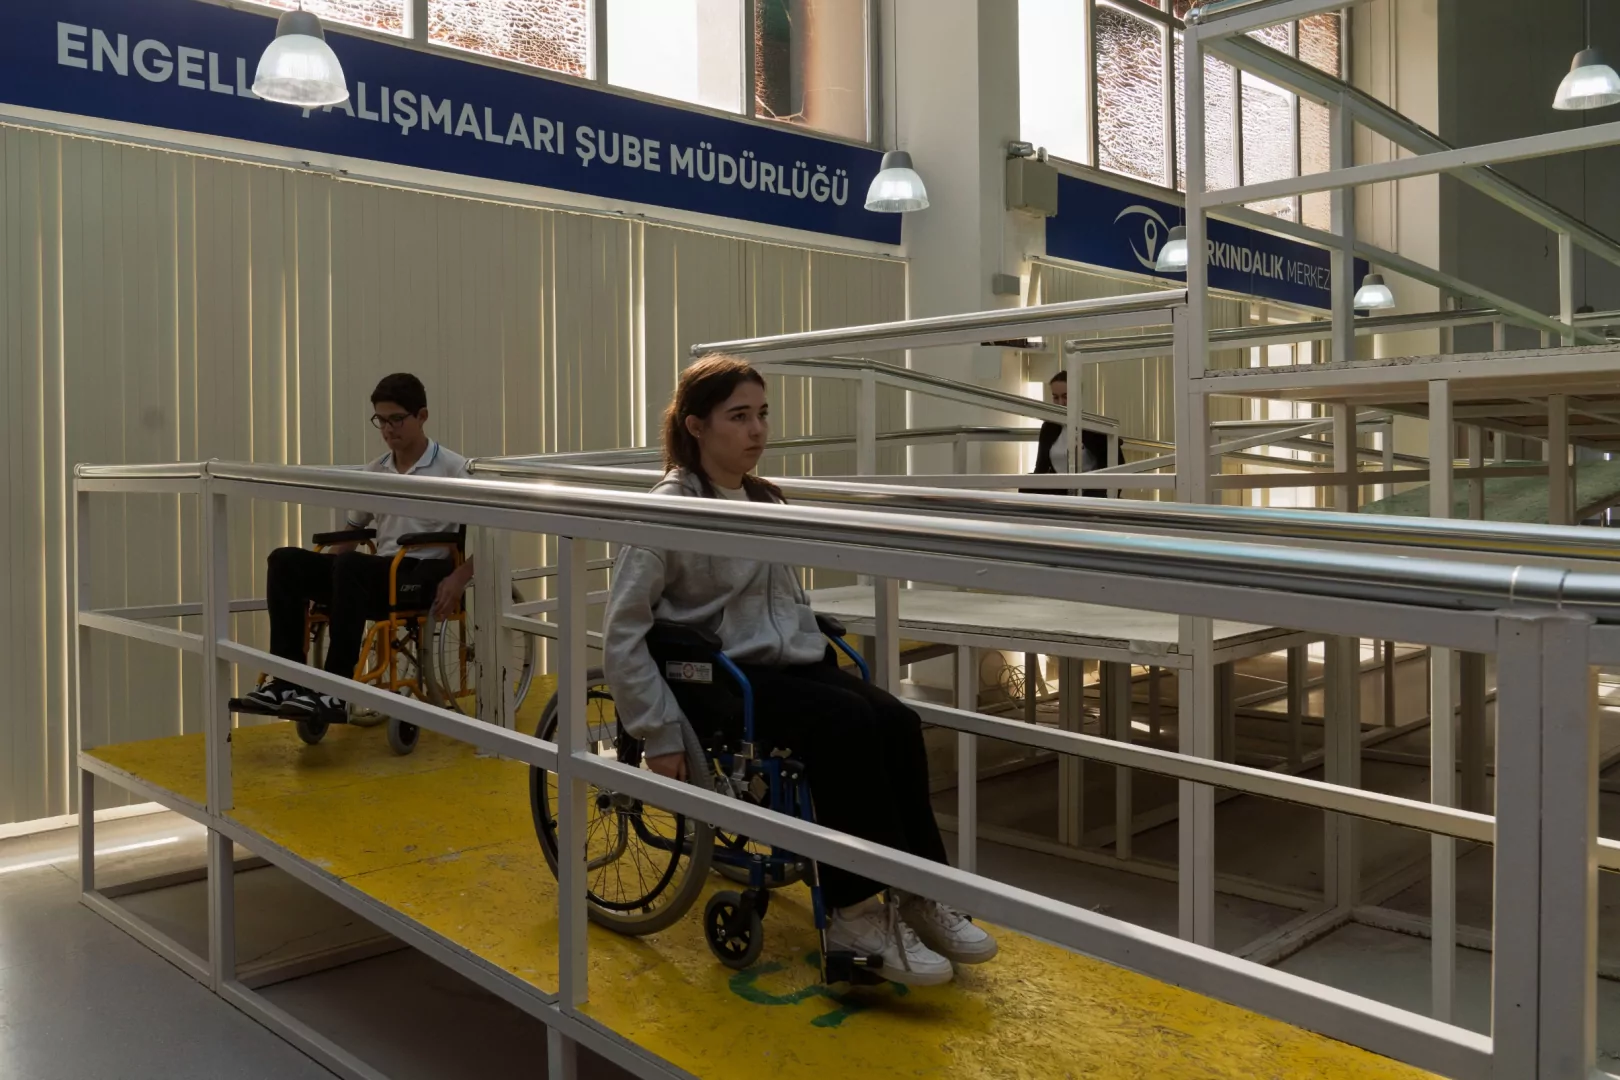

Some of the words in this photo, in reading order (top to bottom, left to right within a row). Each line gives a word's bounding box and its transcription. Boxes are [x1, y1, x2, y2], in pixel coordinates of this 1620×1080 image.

[57, 22, 272, 101] ENGELL
[302, 82, 564, 155] LIŞMALARI
[576, 125, 660, 173] ŞUBE
[670, 142, 849, 206] MÜDÜRLÜĞÜ
